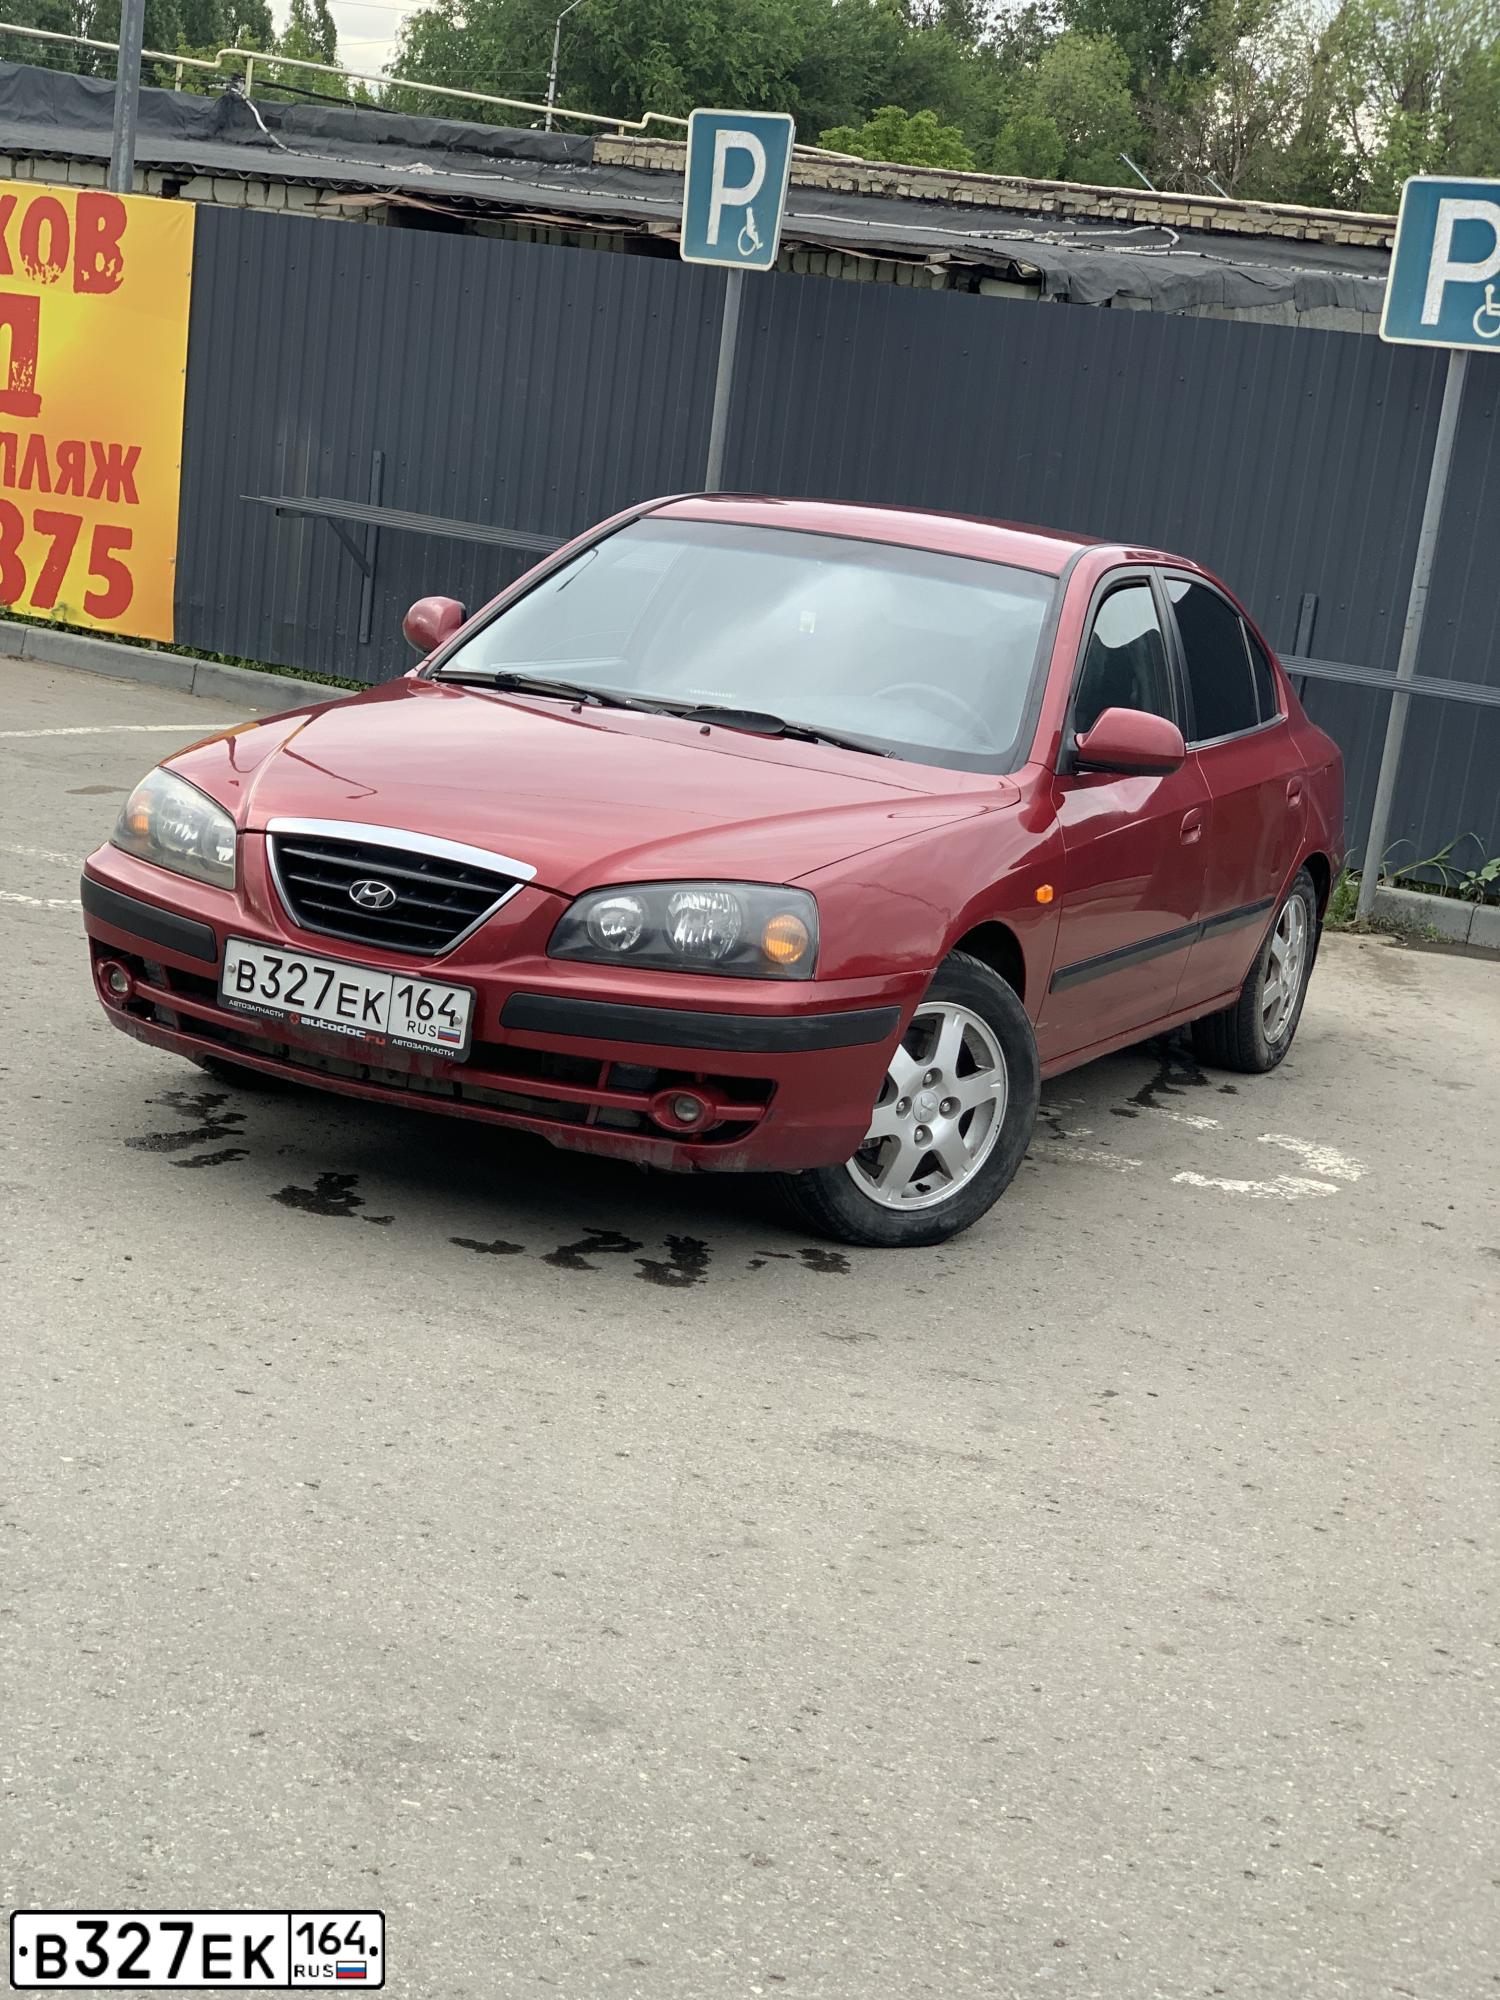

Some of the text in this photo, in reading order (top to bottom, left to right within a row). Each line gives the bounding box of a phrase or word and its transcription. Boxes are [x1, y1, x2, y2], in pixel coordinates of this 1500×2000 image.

[706, 129, 767, 245] P
[1421, 198, 1500, 325] P
[228, 1000, 285, 1019] АВТОЗАПЧАСТИ
[236, 955, 456, 1027] В327ЕК 164
[391, 1038, 455, 1057] АВТОЗАПЧАСТИ
[407, 1020, 437, 1038] RUS
